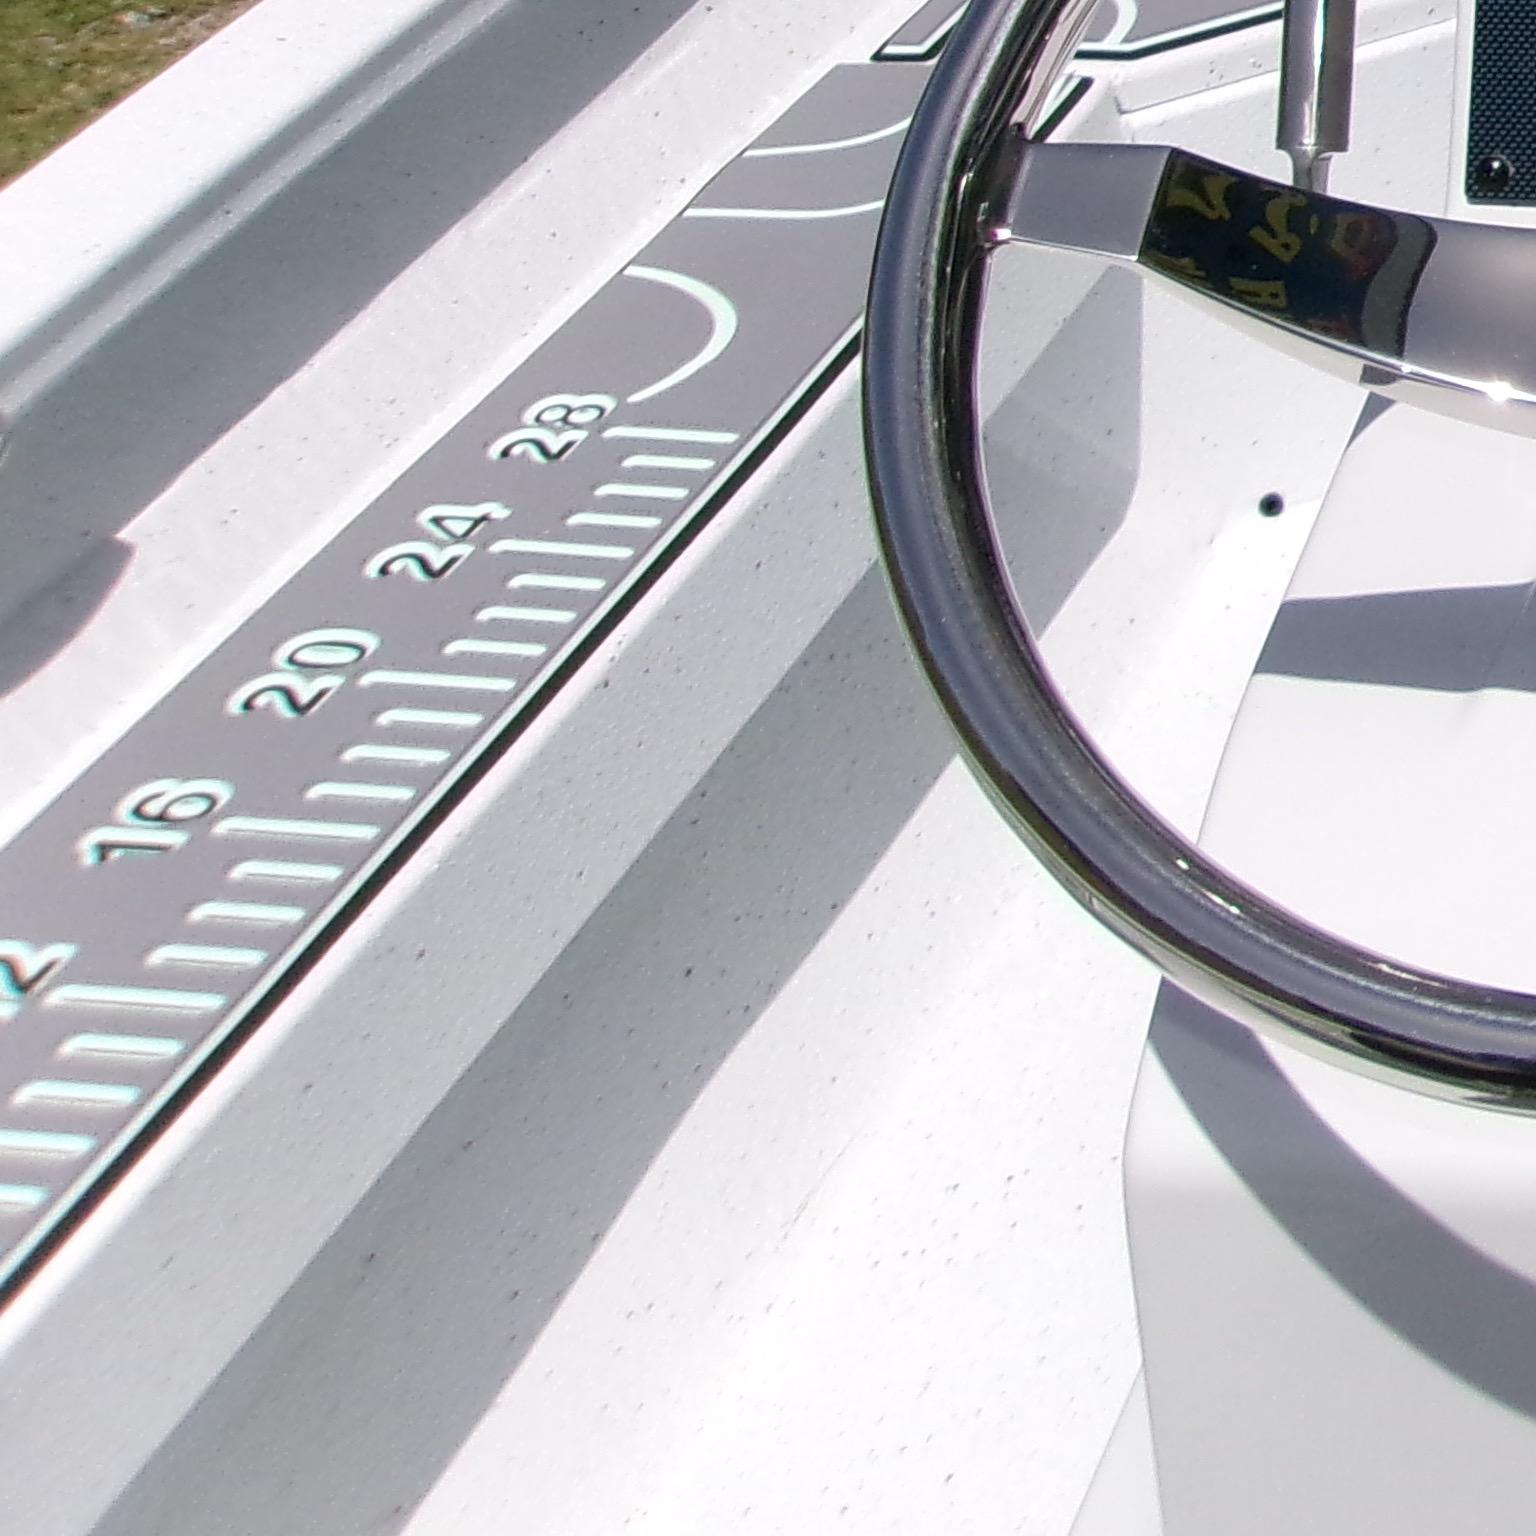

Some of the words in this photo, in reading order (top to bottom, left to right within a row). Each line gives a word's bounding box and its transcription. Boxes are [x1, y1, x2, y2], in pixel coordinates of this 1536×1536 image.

[489, 393, 618, 463] 28
[364, 500, 513, 582] 24
[227, 628, 381, 717] 20
[78, 778, 236, 865] 16
[0, 938, 80, 1018] 2
